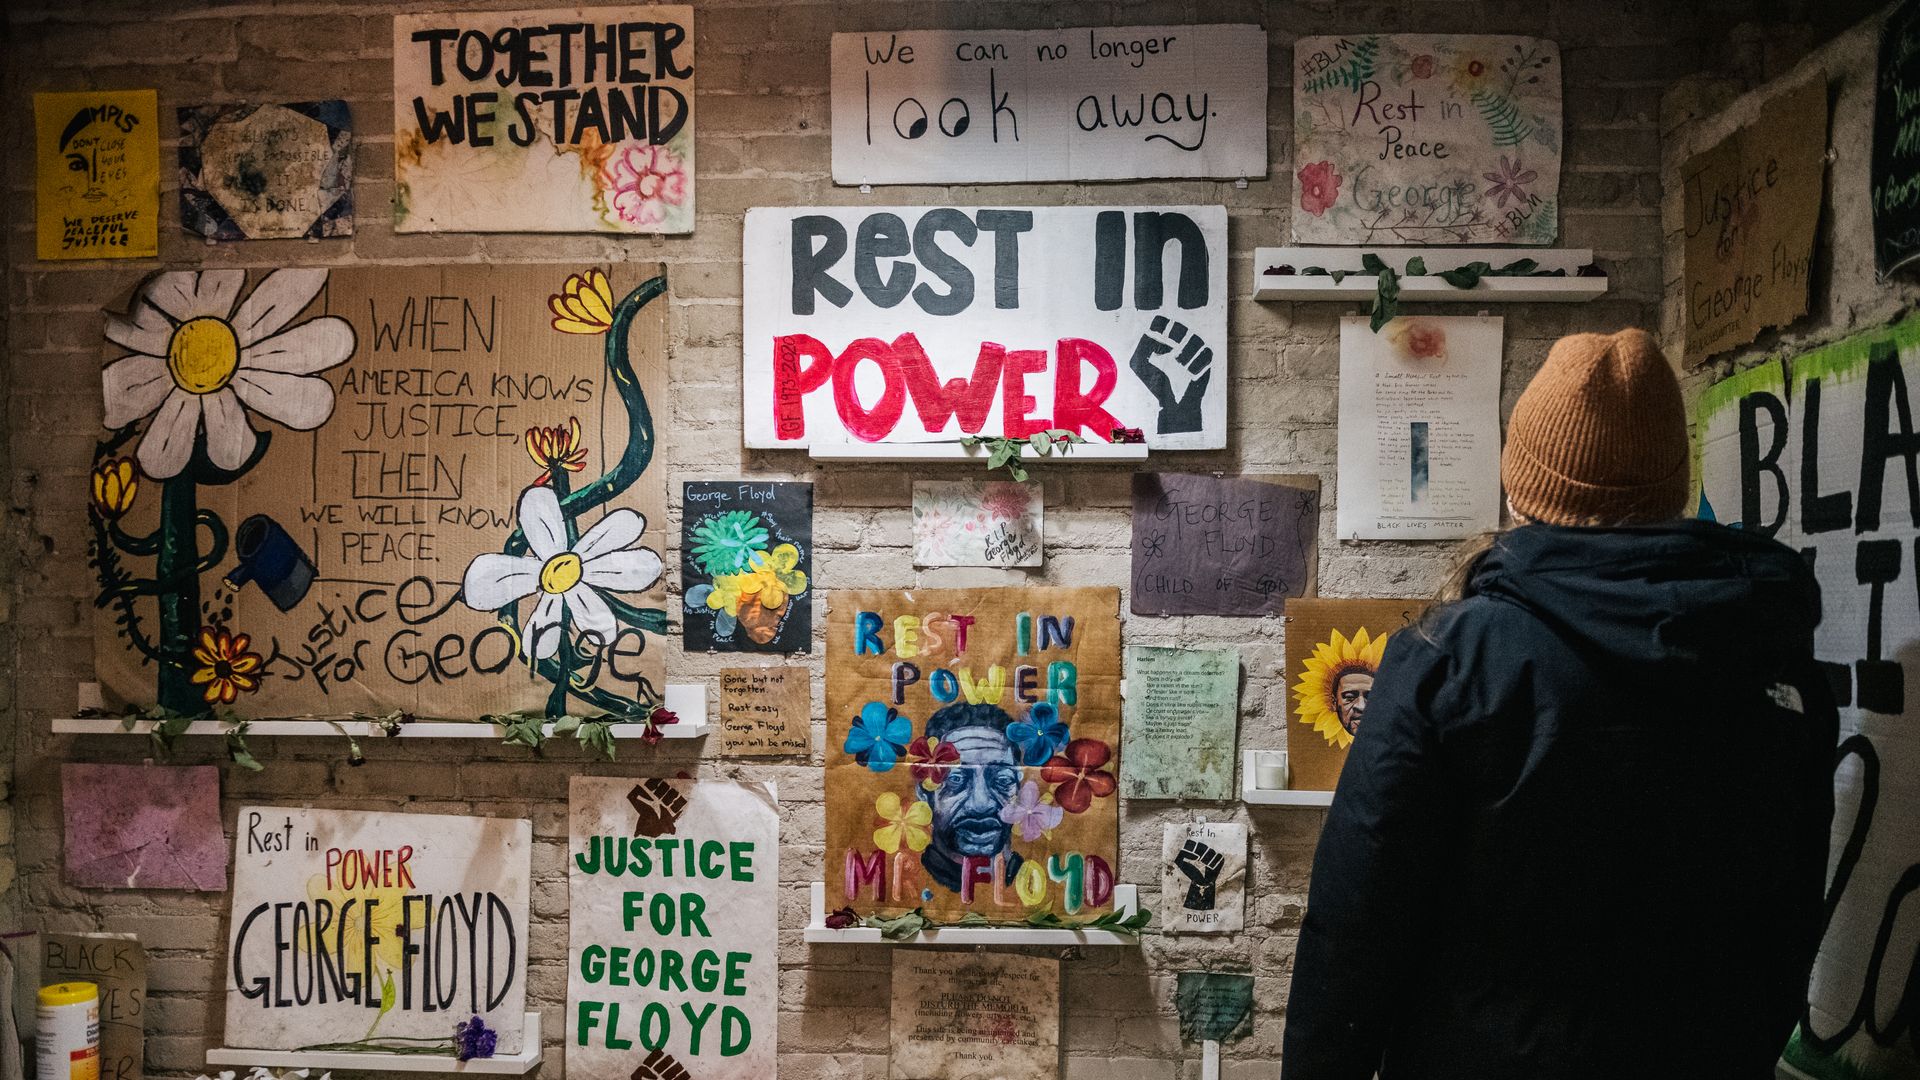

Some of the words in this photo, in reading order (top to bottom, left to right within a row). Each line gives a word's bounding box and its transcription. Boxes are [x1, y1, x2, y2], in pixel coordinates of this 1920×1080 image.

[863, 34, 915, 65] We
[955, 41, 1009, 62] can
[1037, 42, 1068, 62] no
[1090, 29, 1177, 68] longer
[1301, 38, 1355, 77] #BLM
[91, 104, 140, 133] MPLS
[412, 91, 498, 147] WE
[507, 84, 689, 147] STAND
[865, 66, 1019, 146] look
[1076, 91, 1217, 152] away.
[1351, 80, 1425, 127] Rest
[1440, 100, 1464, 121] in
[1378, 125, 1450, 160] Peace
[100, 168, 127, 184] EYES
[1353, 163, 1475, 224] George
[1685, 157, 1779, 239] Justice
[63, 216, 83, 228] WE
[91, 210, 139, 224] DESERVE
[64, 222, 128, 238] PEACEFUL
[1493, 193, 1543, 239] #BLM
[62, 235, 128, 250] JUSTICE
[1692, 274, 1763, 330] George
[369, 295, 496, 353] WHEN
[339, 367, 474, 397] AMERICA
[491, 372, 594, 402] KNOWS
[772, 331, 1120, 444] POWER
[353, 401, 520, 444] JUSTICE,
[342, 450, 467, 498] THEN
[686, 484, 732, 509] George
[738, 483, 776, 504] Floyd
[300, 504, 343, 525] WE
[357, 504, 426, 525] WILL
[438, 504, 514, 529] KNOW
[1155, 488, 1274, 541] GEORGE
[342, 531, 441, 565] PEACE.
[984, 533, 1017, 561] George
[1204, 530, 1275, 559] FLOYD
[1144, 574, 1194, 595] CHILD
[1216, 577, 1234, 592] OF
[1255, 573, 1290, 600] GOD
[262, 575, 464, 682] Justice
[854, 611, 976, 659] REST
[1016, 611, 1076, 657] IN
[384, 621, 650, 690] George
[723, 674, 747, 684] Gone
[752, 673, 768, 684] but
[770, 674, 784, 684] not
[723, 684, 769, 697] forgotten.
[891, 660, 1078, 707] POWER
[724, 719, 753, 735] George
[757, 720, 785, 737] Floyd
[754, 705, 779, 718] easy
[725, 741, 744, 751] you
[748, 738, 764, 748] will
[768, 738, 779, 748] be
[781, 738, 806, 749] missed
[248, 812, 293, 854] Rest
[305, 832, 318, 851] in
[1186, 826, 1204, 837] Rest
[326, 845, 416, 891] POWER
[575, 835, 755, 882] JUSTICE
[844, 847, 934, 902] MR.
[960, 851, 1115, 915] FLOYD
[622, 891, 712, 937] FOR
[1186, 913, 1219, 923] POWER
[46, 941, 135, 972] BLACK
[233, 897, 382, 1009] GEORGE
[401, 891, 517, 1014] FLOYD
[580, 944, 752, 996] GEORGE
[913, 966, 936, 974] Thank
[938, 969, 953, 977] you
[914, 1007, 953, 1018] (including
[920, 1000, 962, 1010] DISTURB
[941, 993, 974, 1001] PLEASE
[577, 1001, 752, 1057] FLOYD
[946, 1034, 956, 1044] by
[953, 1051, 977, 1060] Thank
[979, 1053, 993, 1062] you
